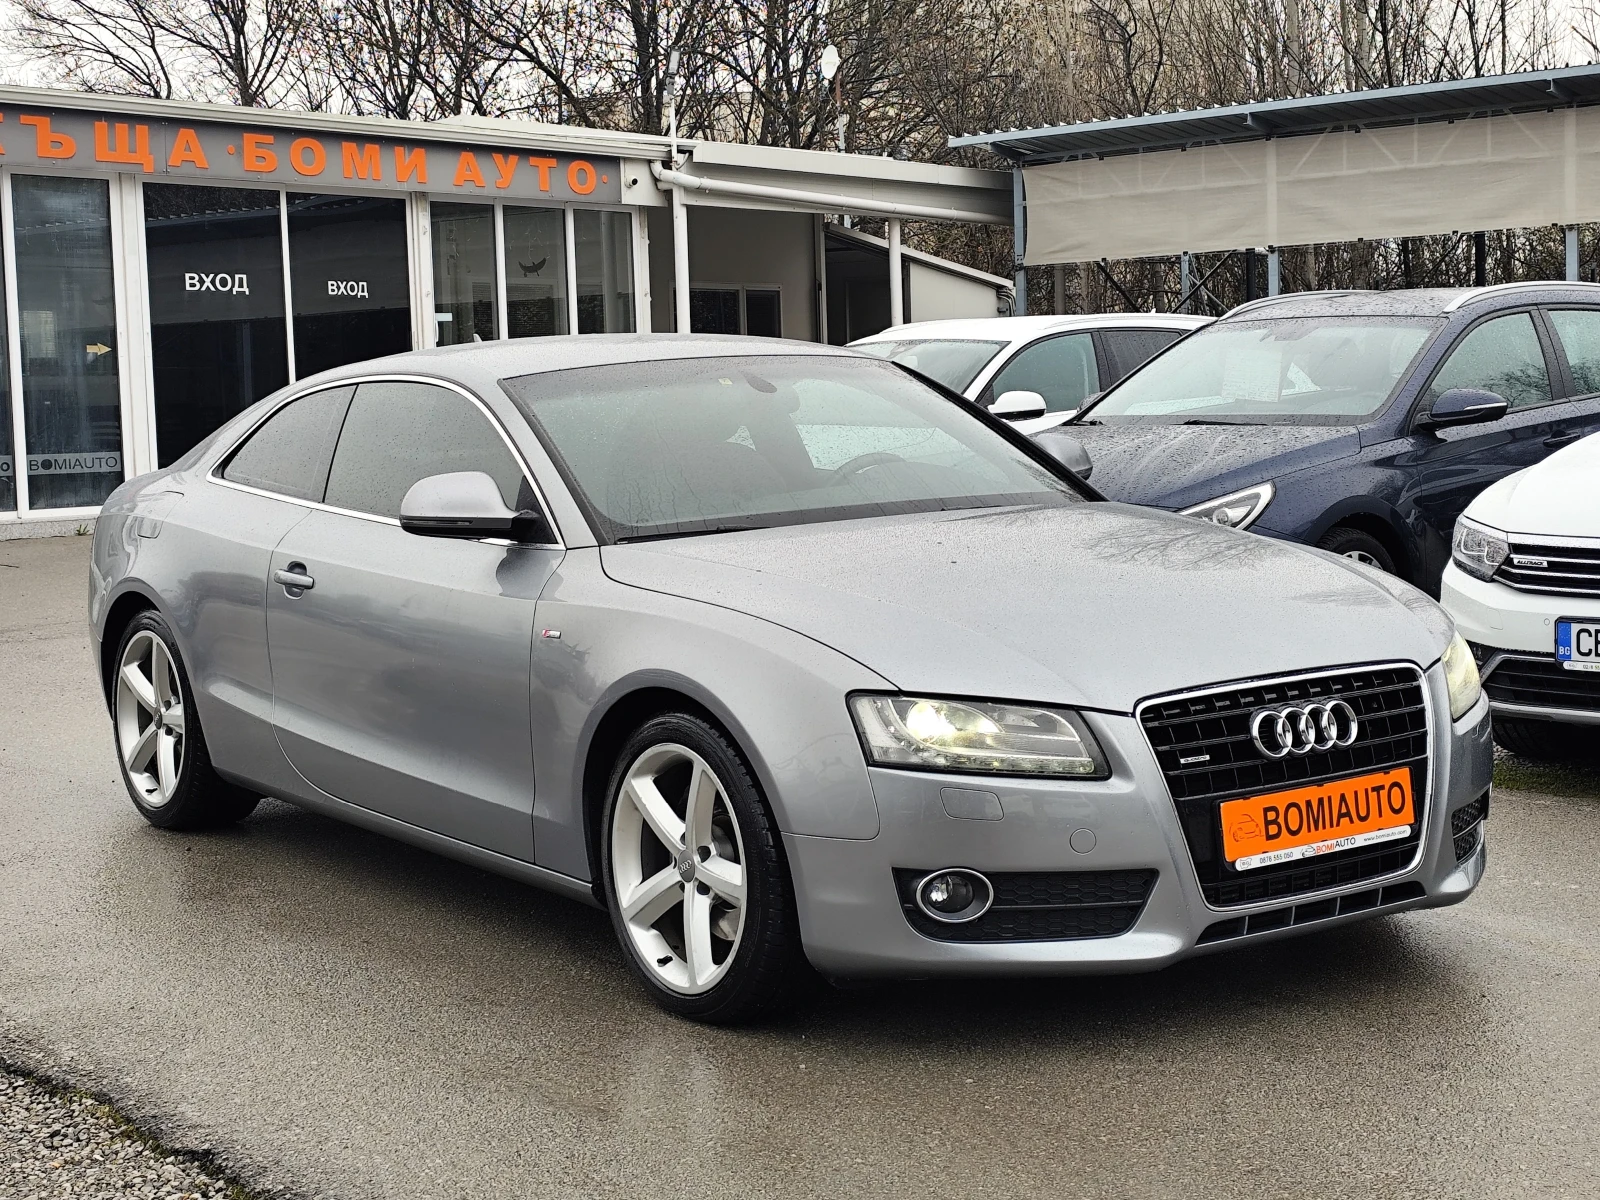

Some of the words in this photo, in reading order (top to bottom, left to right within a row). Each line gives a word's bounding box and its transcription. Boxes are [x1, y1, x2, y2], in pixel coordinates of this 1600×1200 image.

[0, 112, 209, 173] ЪЩА
[184, 273, 249, 295] ВХОД
[327, 280, 369, 298] ВХОД
[29, 457, 118, 471] BOMIAUTO
[1559, 646, 1571, 656] BG
[1262, 781, 1406, 841] BOMIAUTO
[1315, 837, 1357, 854] BOMIAUTO
